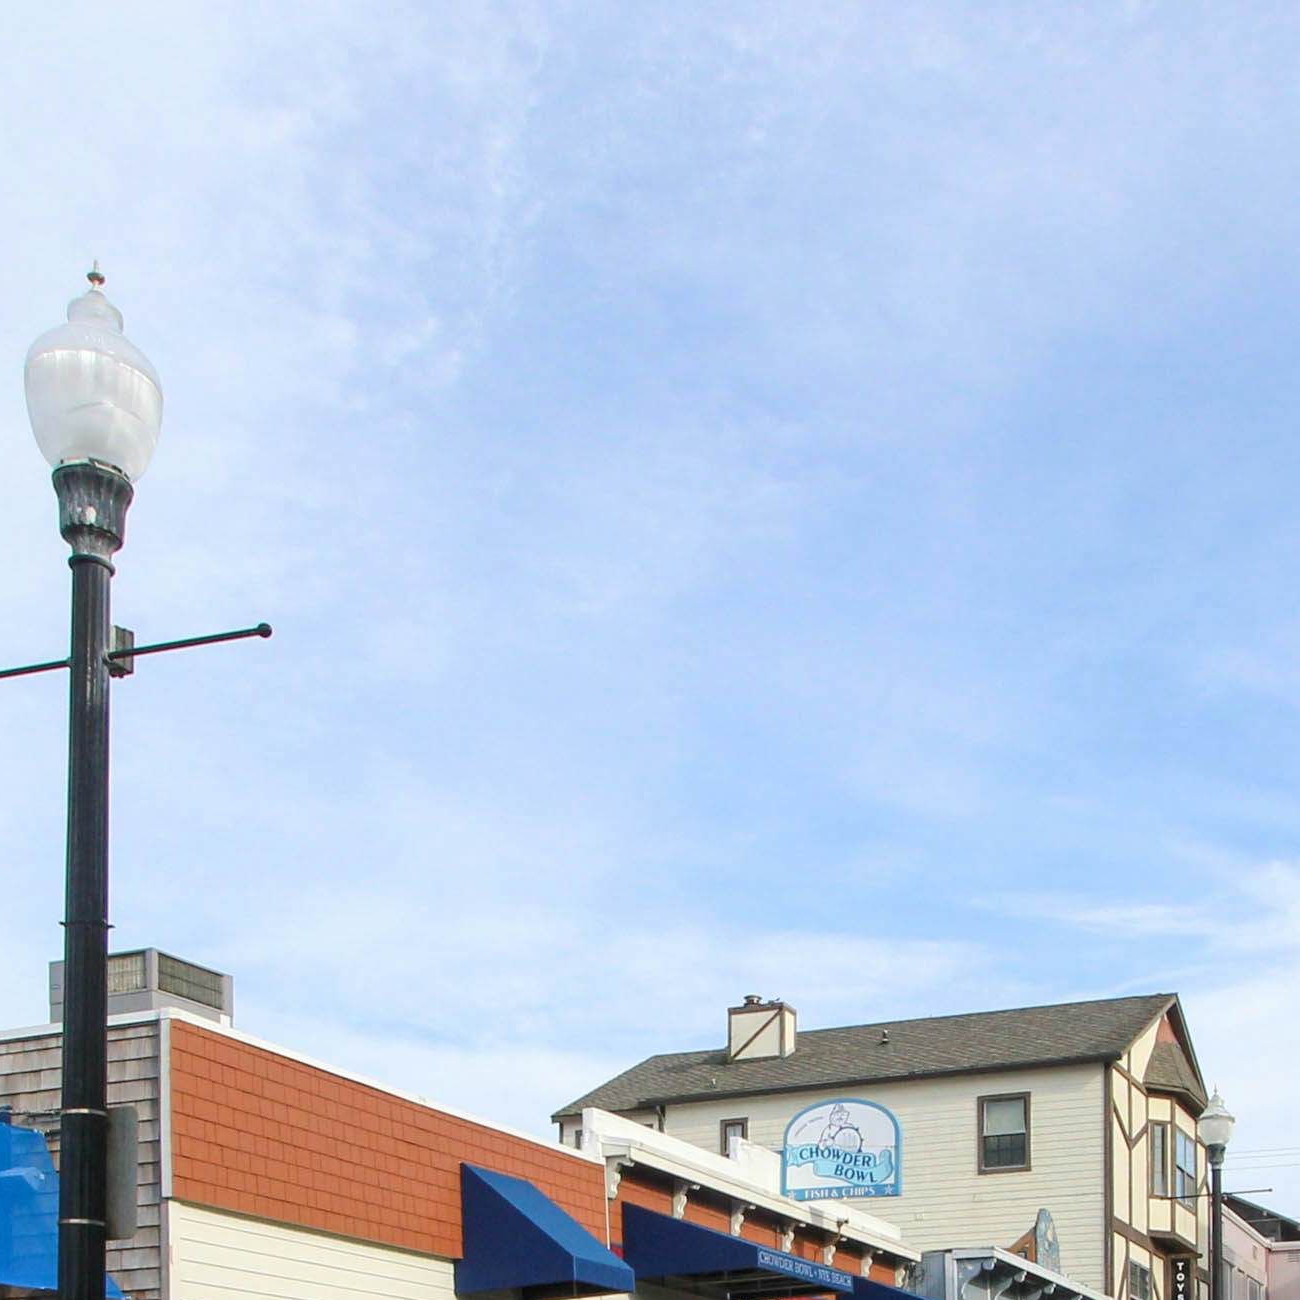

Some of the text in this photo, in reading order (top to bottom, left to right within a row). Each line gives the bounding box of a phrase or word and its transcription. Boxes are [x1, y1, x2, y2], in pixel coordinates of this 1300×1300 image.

[799, 1147, 872, 1167] CHOWDER
[834, 1165, 878, 1183] BOWL
[804, 1186, 876, 1199] FISH & CHIPS
[759, 1251, 794, 1271] CHOWDER
[794, 1262, 813, 1277] BOWL
